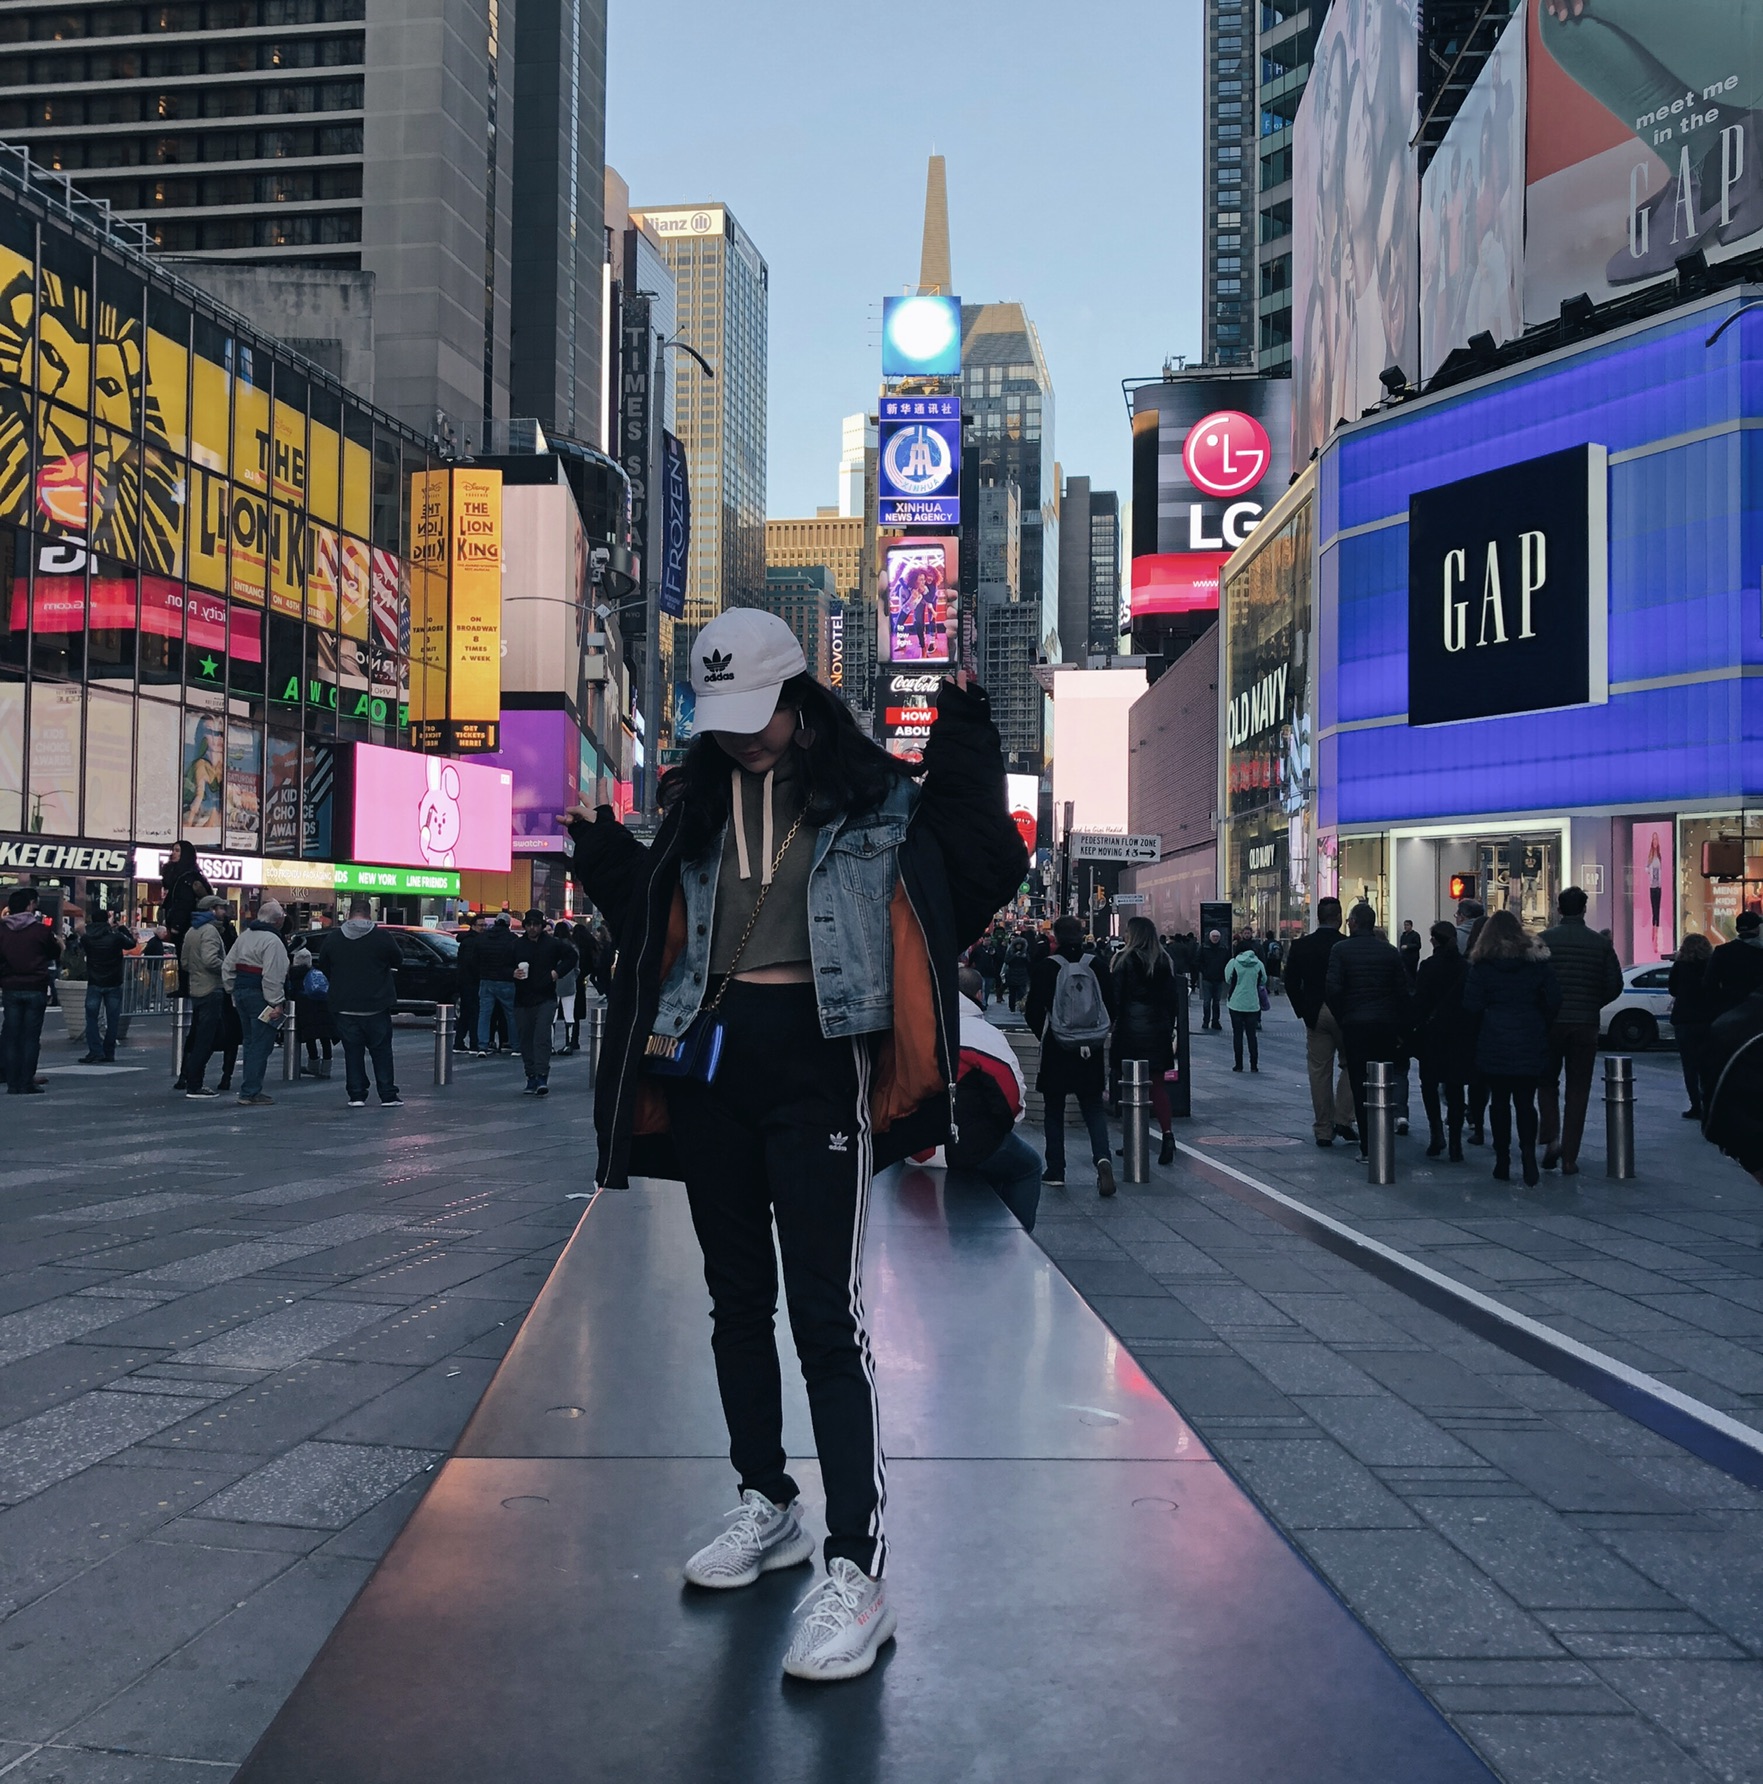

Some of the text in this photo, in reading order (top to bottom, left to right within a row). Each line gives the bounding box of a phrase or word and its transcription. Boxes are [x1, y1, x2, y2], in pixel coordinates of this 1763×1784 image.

[1636, 75, 1739, 130] meet me
[1653, 108, 1719, 146] in the
[1630, 124, 1745, 259] GAP
[650, 217, 688, 232] lianz
[625, 327, 645, 441] TIMES
[886, 403, 952, 415] 新华通讯社
[255, 428, 305, 489] THE
[461, 480, 490, 494] Disney
[464, 502, 488, 514] THE
[895, 502, 943, 513] XINHUA
[200, 470, 281, 562] LION
[666, 455, 686, 593] FROZEN
[885, 513, 953, 522] NEWS AGENCY
[459, 515, 494, 536] LION
[1189, 501, 1263, 550] LG
[456, 537, 499, 561] KING
[233, 579, 265, 600] ENTRANCE
[272, 594, 283, 605] ON
[285, 596, 300, 611] 45TH
[1443, 530, 1547, 652] GAP
[456, 625, 498, 633] BROADWAY
[472, 635, 479, 643] 8
[830, 609, 844, 688] NOVOTEL
[703, 671, 735, 683] adidas
[1228, 662, 1289, 750] OLD NAVY
[900, 711, 932, 721] HOW
[455, 731, 486, 739] TICKETS
[894, 726, 931, 736] ABOU
[272, 804, 314, 821] CHOCE
[512, 839, 544, 848] swatch
[1080, 836, 1157, 847] PEDESTRIAN FLOW ZONE
[0, 841, 128, 872] KECHERS
[1080, 846, 1122, 857] KEEP MOVING
[1249, 843, 1275, 870] OLD NAVY
[358, 871, 377, 885] NEW
[378, 873, 397, 886] YORK
[406, 875, 421, 887] LINE
[421, 876, 448, 888] FRIENDS
[1713, 887, 1739, 895] MENS
[1715, 897, 1737, 906] KIDS
[1714, 908, 1737, 916] BABY
